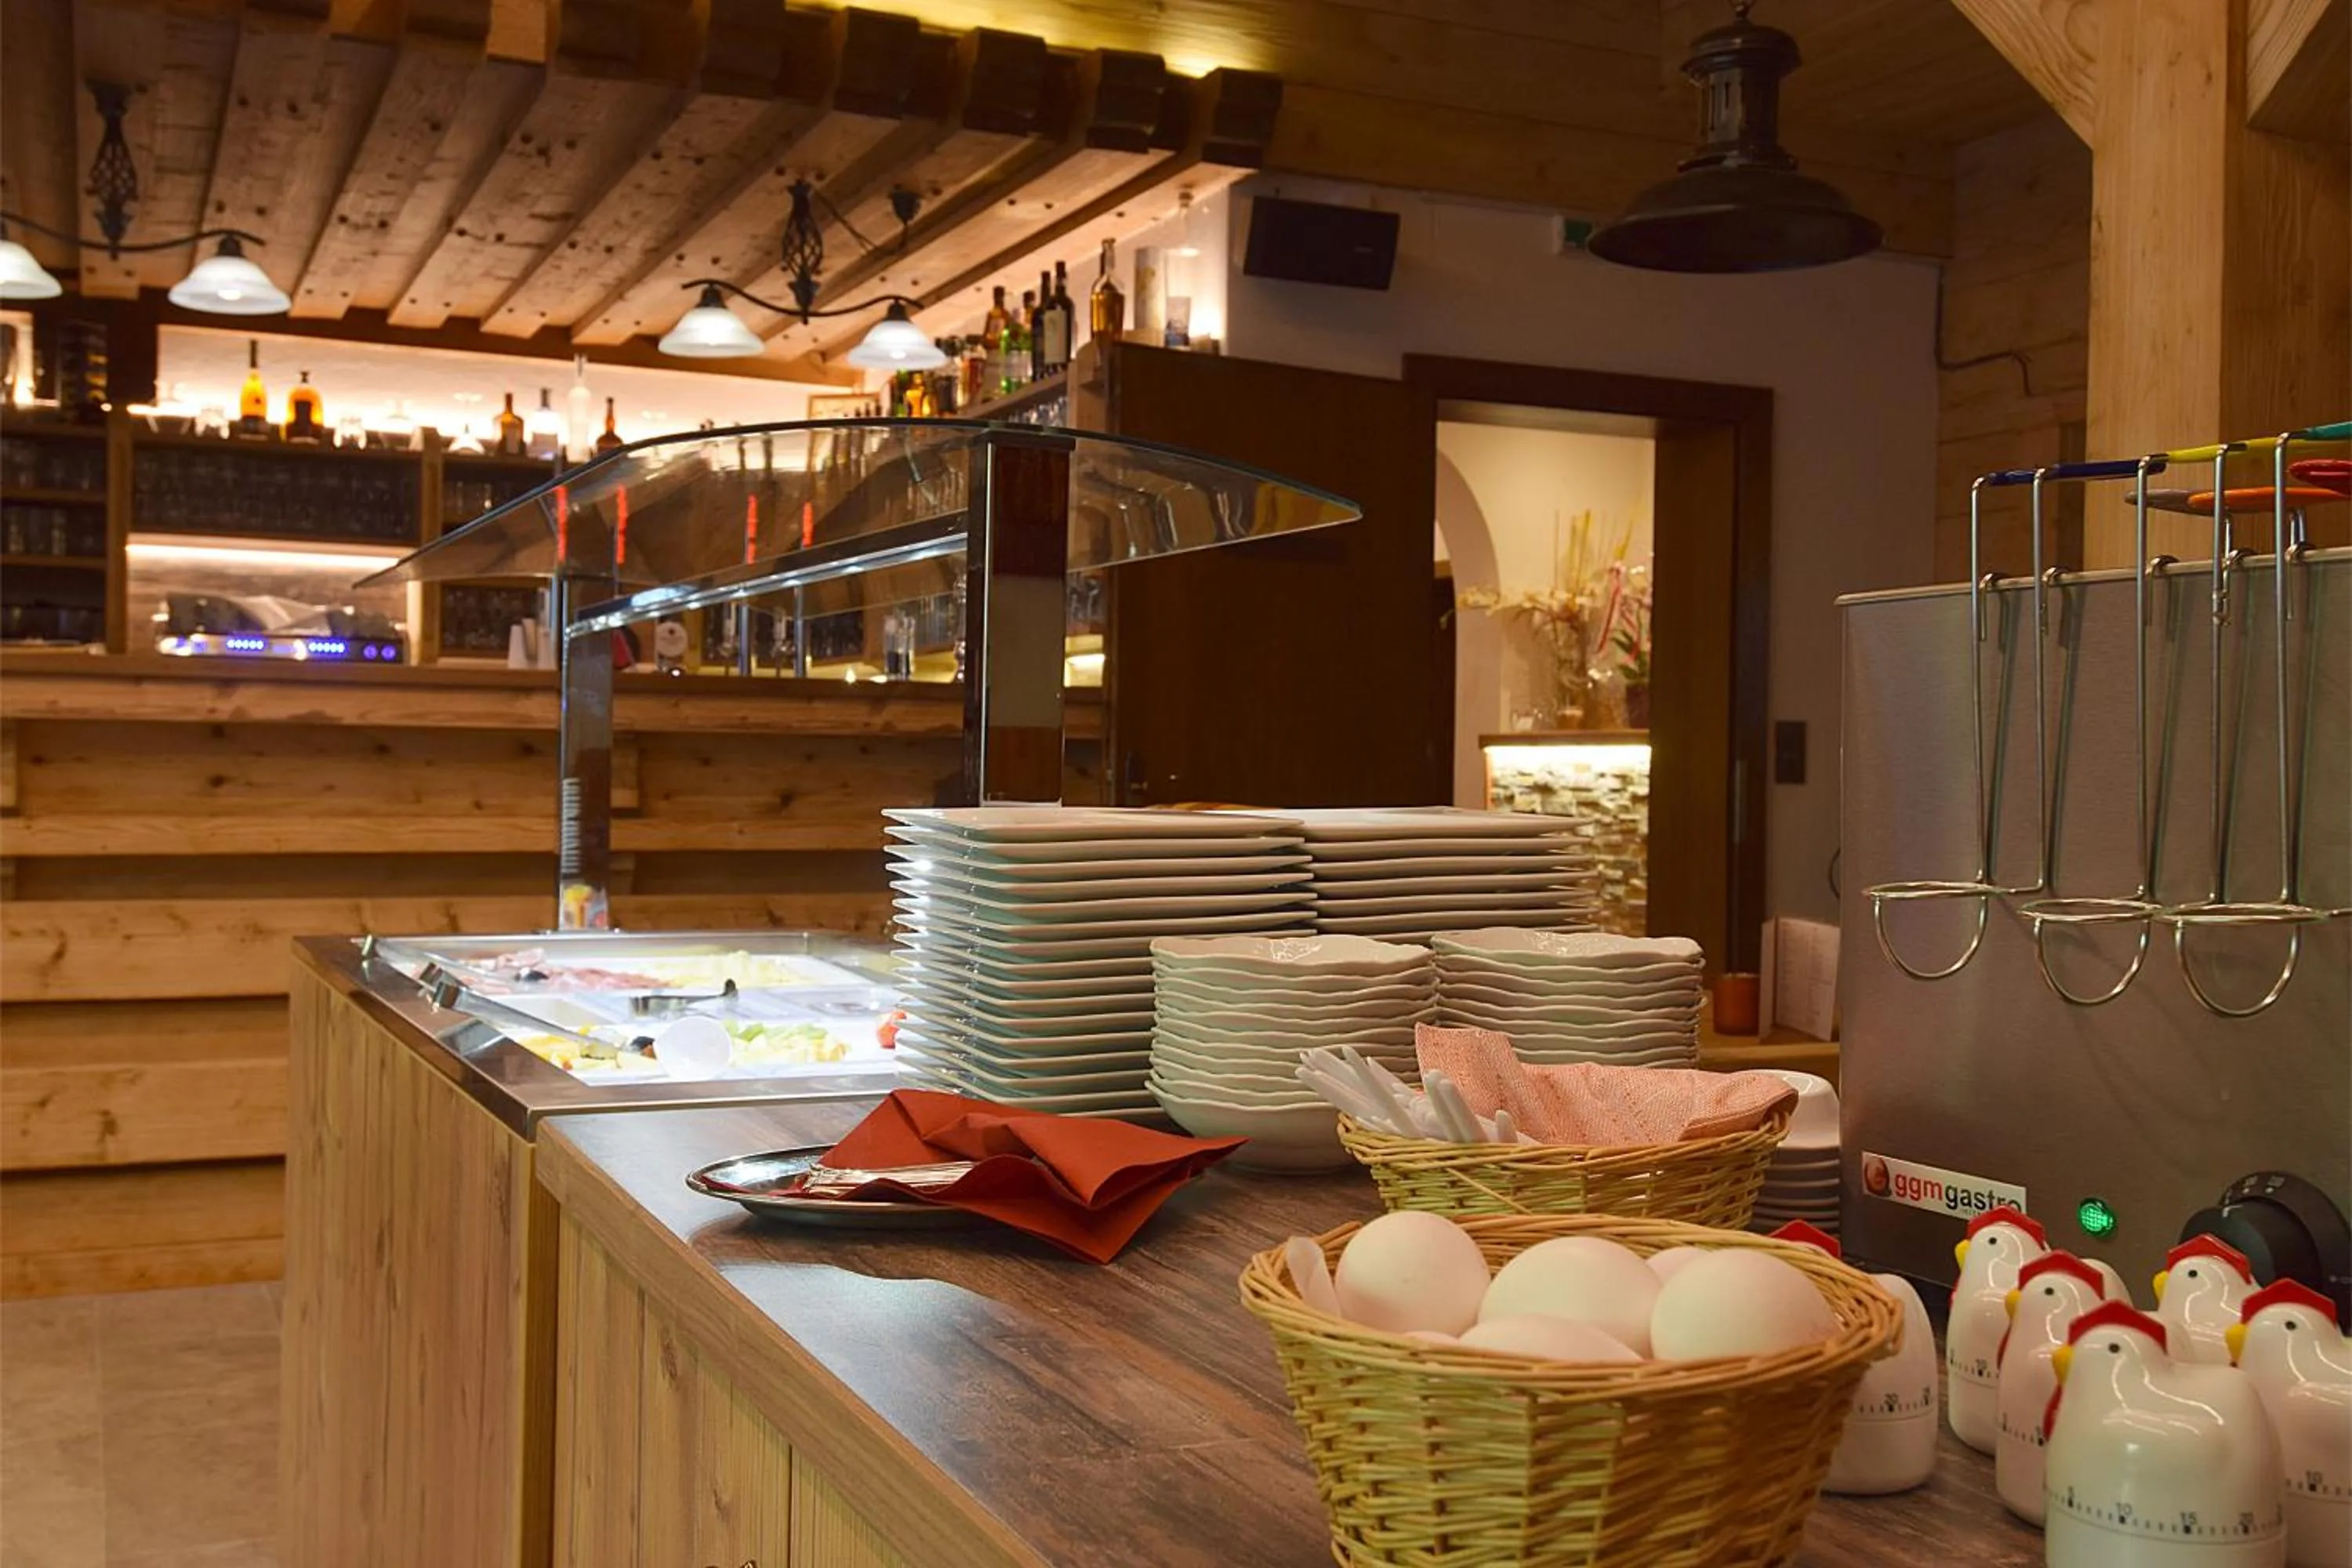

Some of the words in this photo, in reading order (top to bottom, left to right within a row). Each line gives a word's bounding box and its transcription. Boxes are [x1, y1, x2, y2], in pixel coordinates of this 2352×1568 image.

[2305, 1470, 2323, 1485] 10
[2116, 1501, 2132, 1517] 10
[2180, 1511, 2198, 1526] 15
